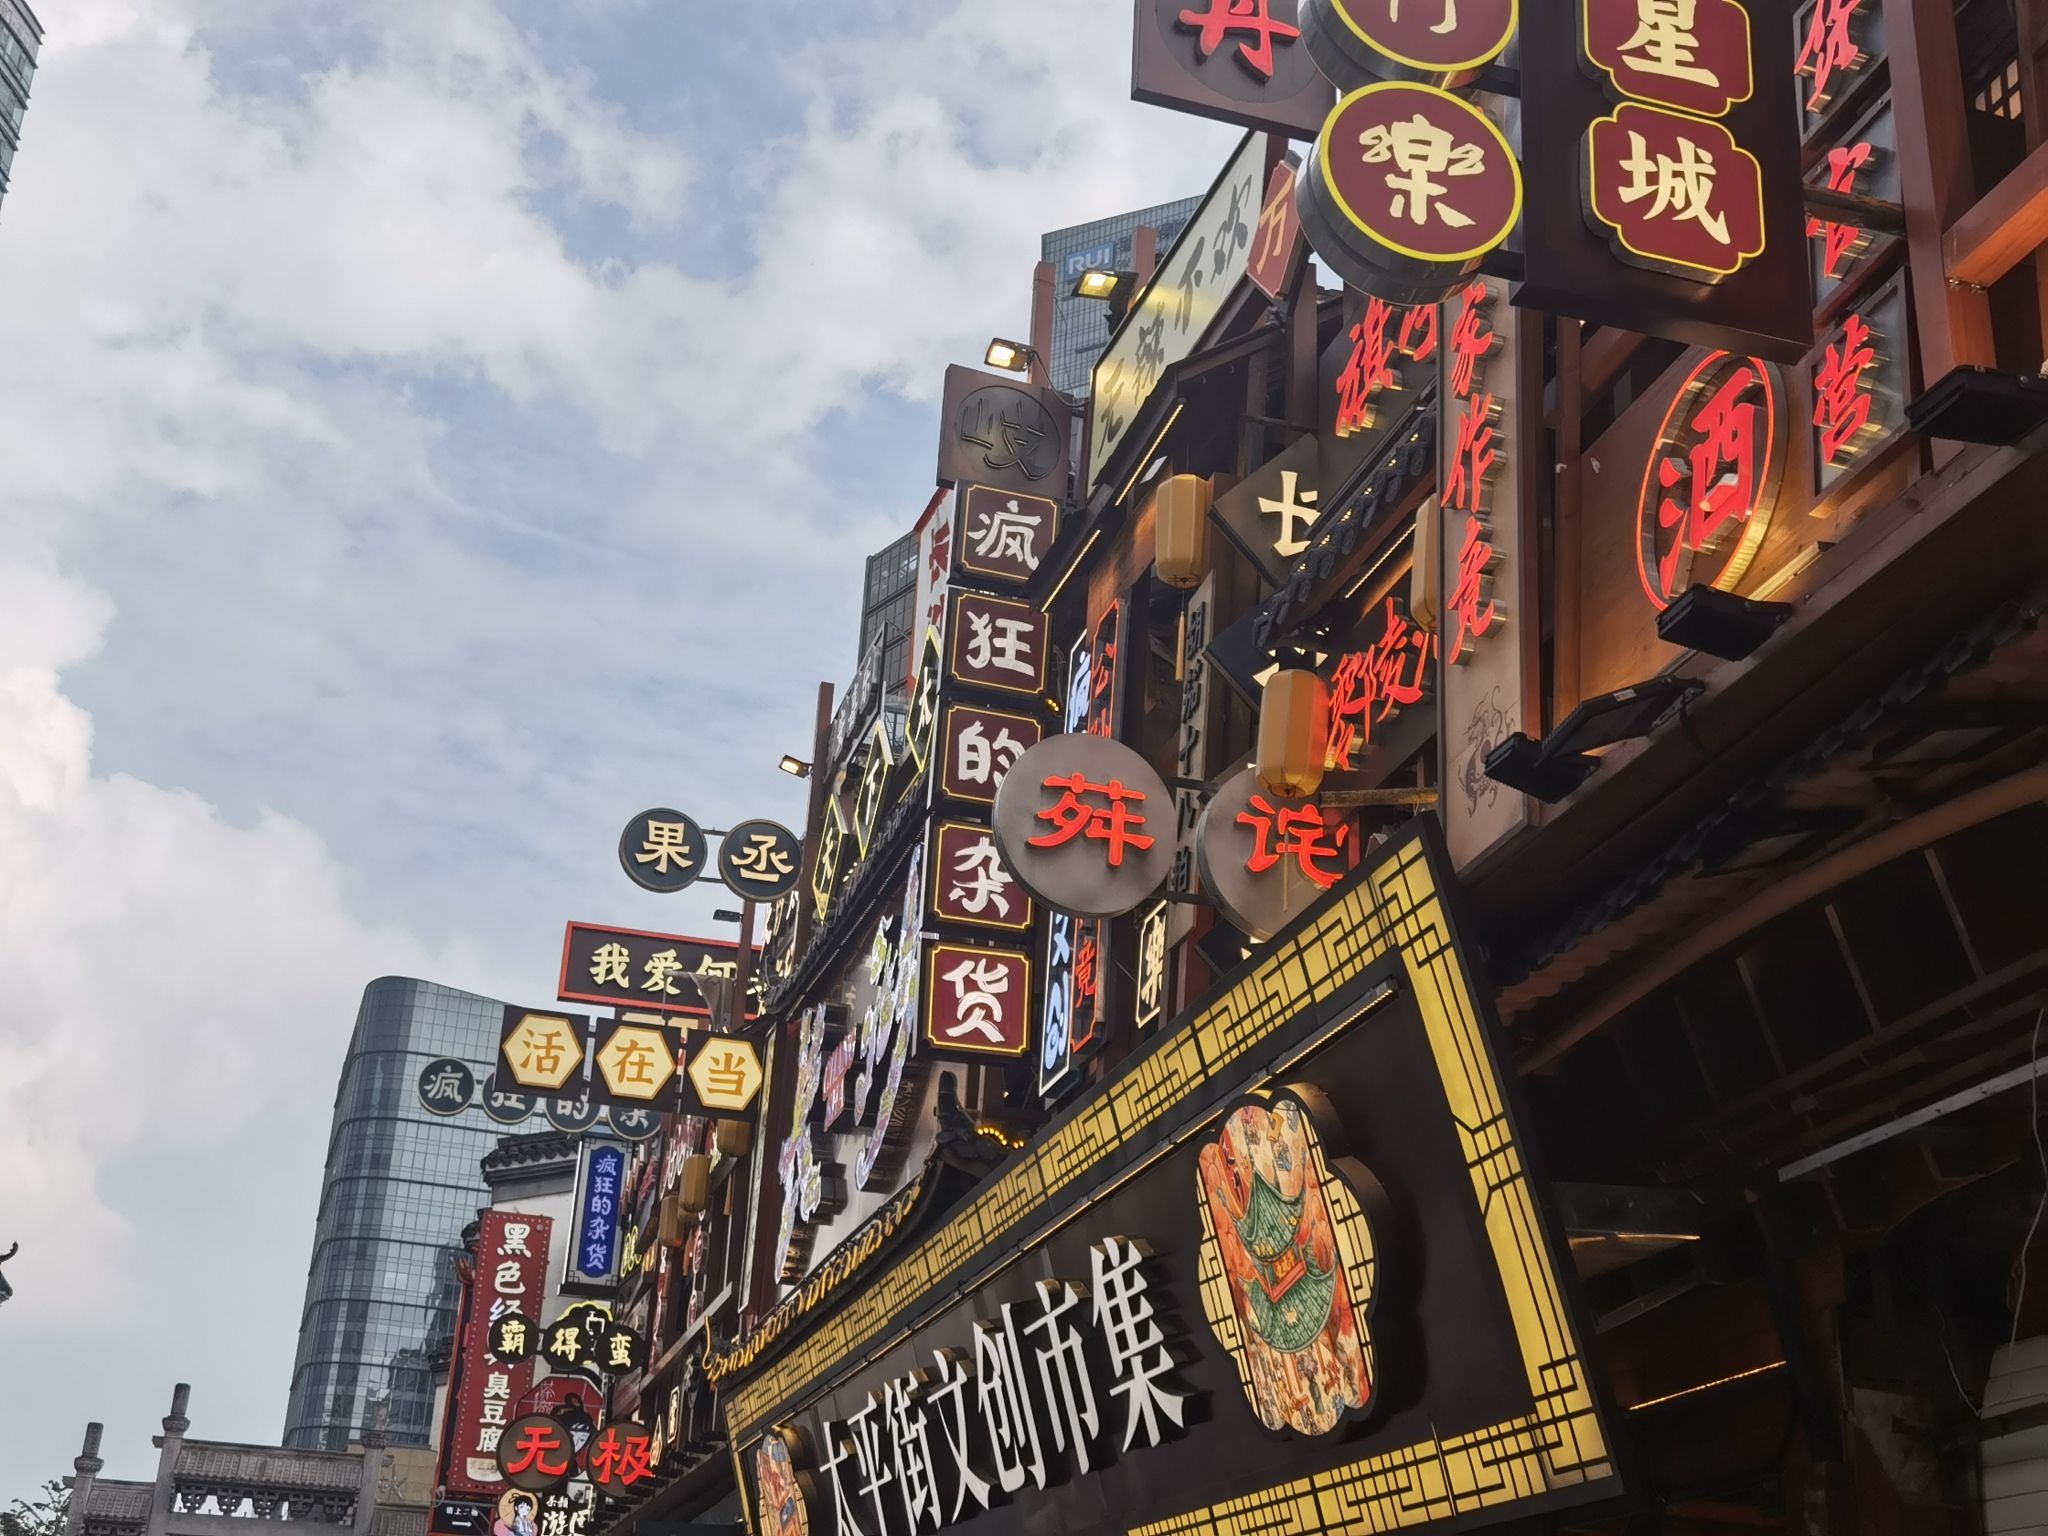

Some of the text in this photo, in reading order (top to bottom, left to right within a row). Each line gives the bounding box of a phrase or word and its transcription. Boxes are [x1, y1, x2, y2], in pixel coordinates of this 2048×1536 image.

[1616, 0, 1731, 244] 星城
[1659, 366, 1754, 600] 酒
[942, 498, 1042, 1042] 疯狂的杂货
[519, 1030, 746, 1097] 活在当
[586, 1154, 617, 1270] 疯狂的杂货
[498, 1319, 633, 1368] 霸得蛮
[819, 1237, 1184, 1536] 太平街文创市集
[507, 1425, 656, 1486] 无极
